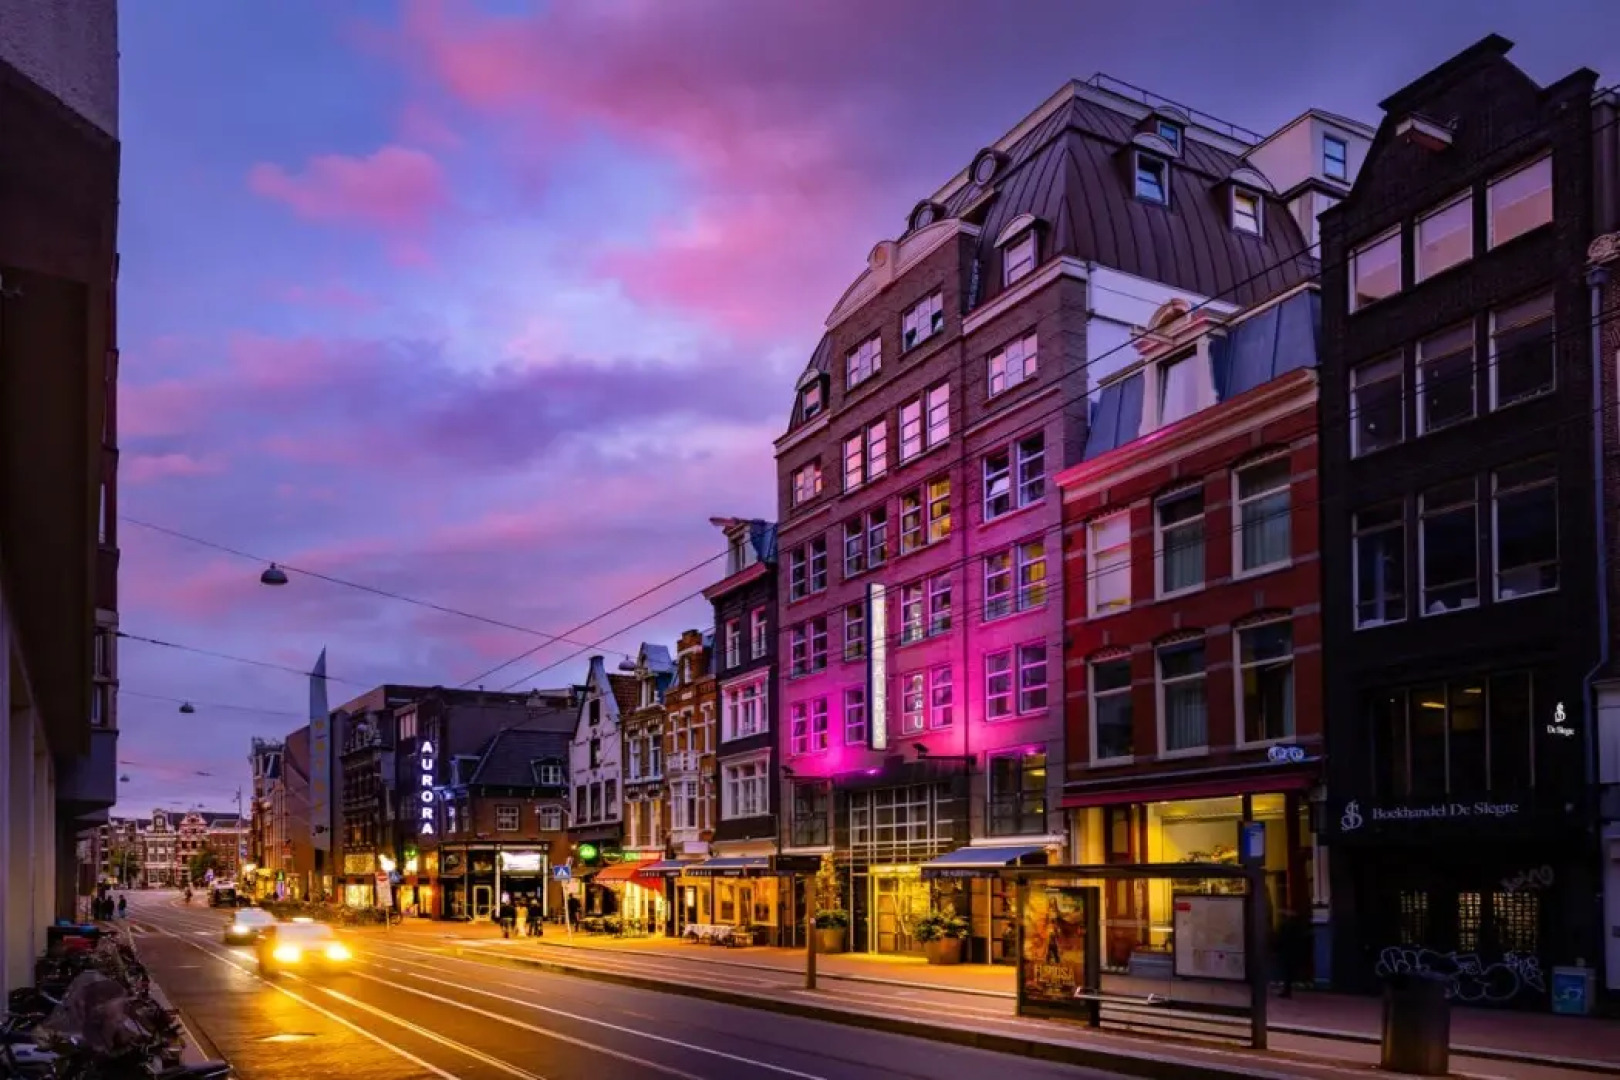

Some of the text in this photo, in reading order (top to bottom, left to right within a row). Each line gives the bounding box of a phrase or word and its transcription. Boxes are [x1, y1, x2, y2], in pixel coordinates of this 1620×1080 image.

[421, 740, 434, 835] AURORA
[1372, 801, 1519, 820] Boekhandel De Slegte
